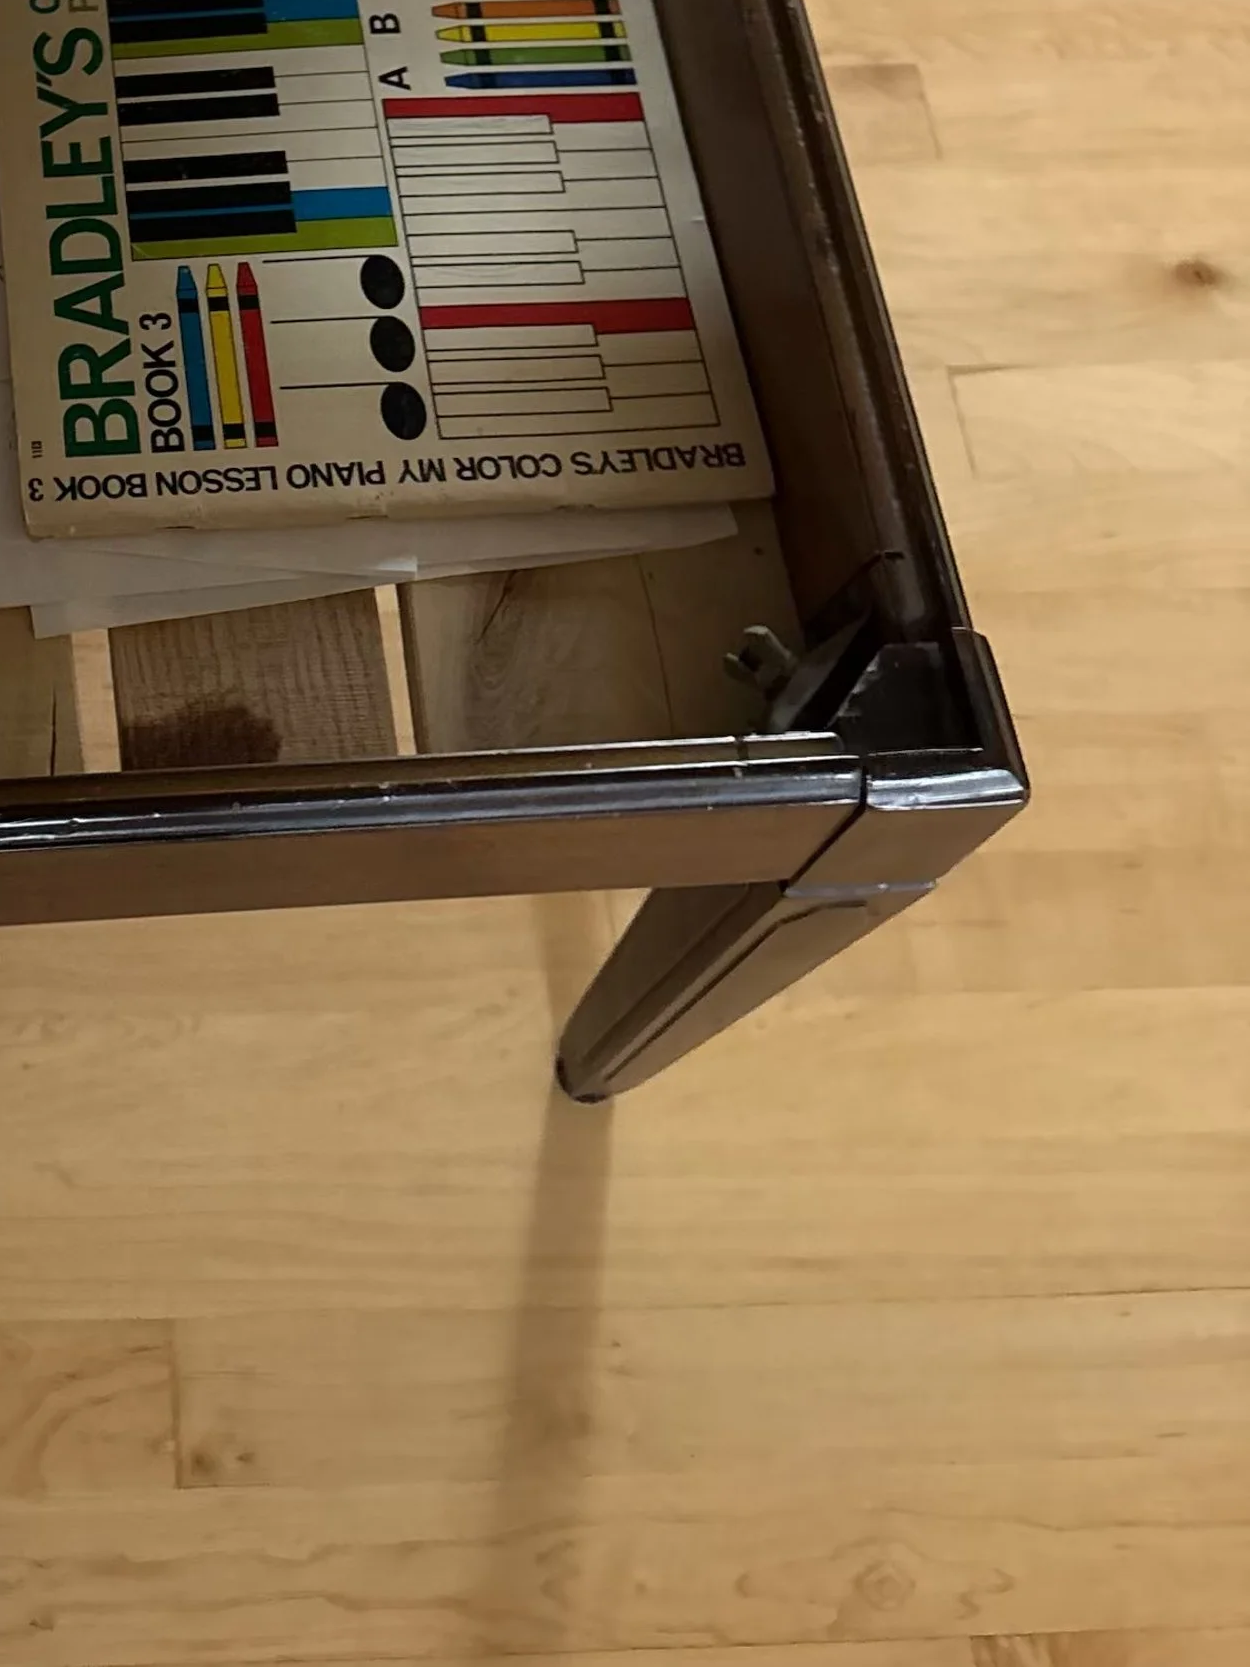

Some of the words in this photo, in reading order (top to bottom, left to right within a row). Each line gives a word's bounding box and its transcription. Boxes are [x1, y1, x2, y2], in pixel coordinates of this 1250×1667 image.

[32, 26, 142, 458] BRADLEY'S
[138, 311, 173, 331] 3
[142, 338, 186, 454] BOOK
[398, 456, 447, 484] MY
[454, 452, 563, 482] COLOR
[569, 441, 747, 476] BRADLEY'S
[28, 477, 45, 502] 3
[53, 472, 148, 502] BOOK
[155, 465, 280, 497] LESSON
[285, 460, 387, 490] PIANO
